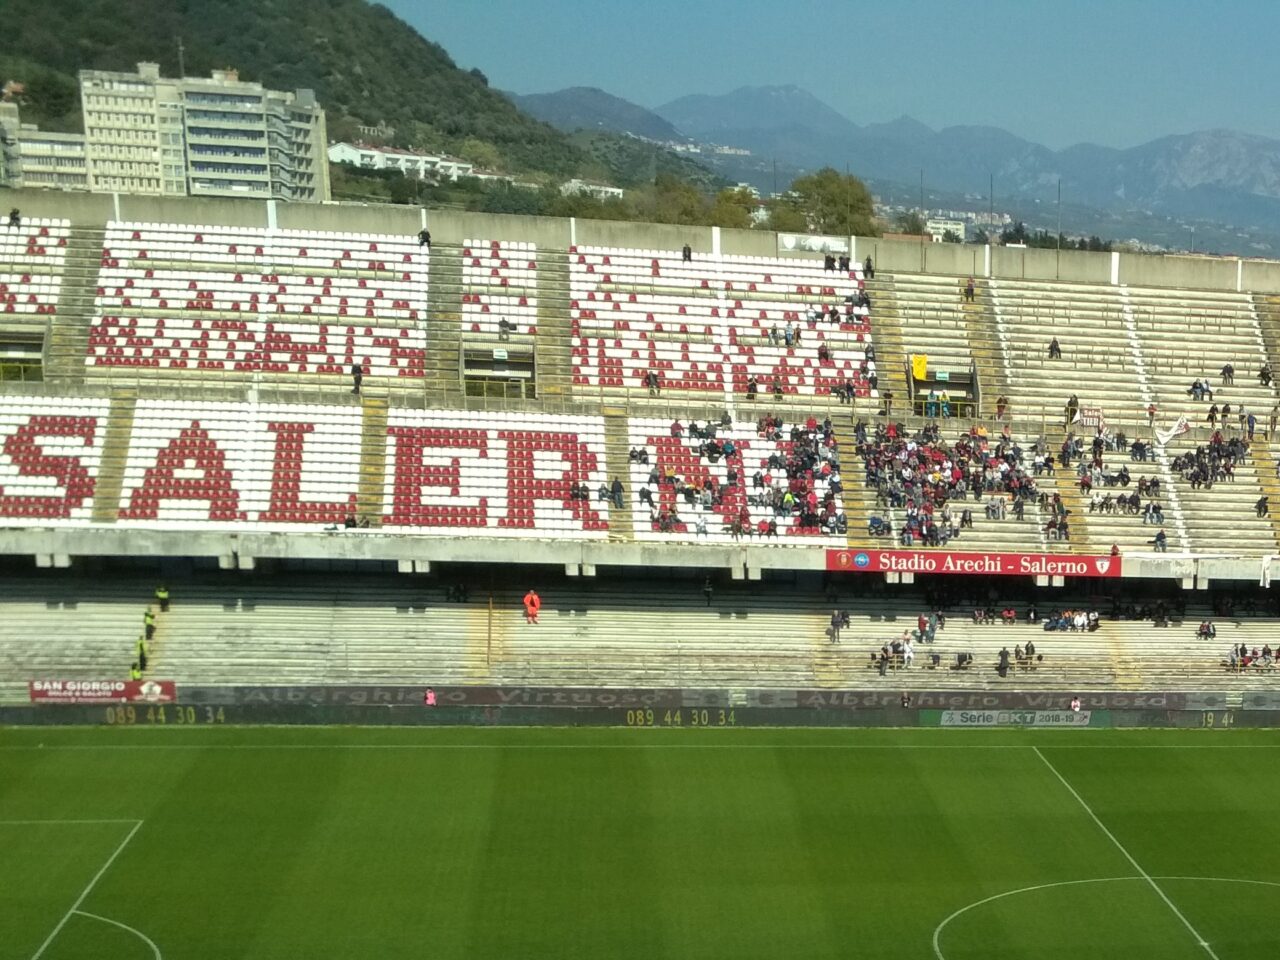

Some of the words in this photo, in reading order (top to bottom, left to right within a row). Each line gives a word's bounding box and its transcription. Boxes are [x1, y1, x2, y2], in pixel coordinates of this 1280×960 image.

[879, 554, 936, 570] Stadio
[942, 555, 1002, 571] Arechi
[1020, 557, 1088, 574] Salerno
[33, 681, 62, 691] SAN
[66, 682, 126, 691] GIORGIO
[805, 692, 1000, 707] Alberhiero
[106, 706, 136, 724] 089
[146, 706, 167, 724] 44
[176, 707, 196, 724] 30
[206, 706, 226, 724] 34
[626, 710, 655, 725] 089
[664, 710, 682, 725] 44
[691, 710, 709, 725] 30
[718, 710, 737, 725] 34
[960, 711, 994, 723] Serie
[1038, 714, 1075, 723] 2018-19
